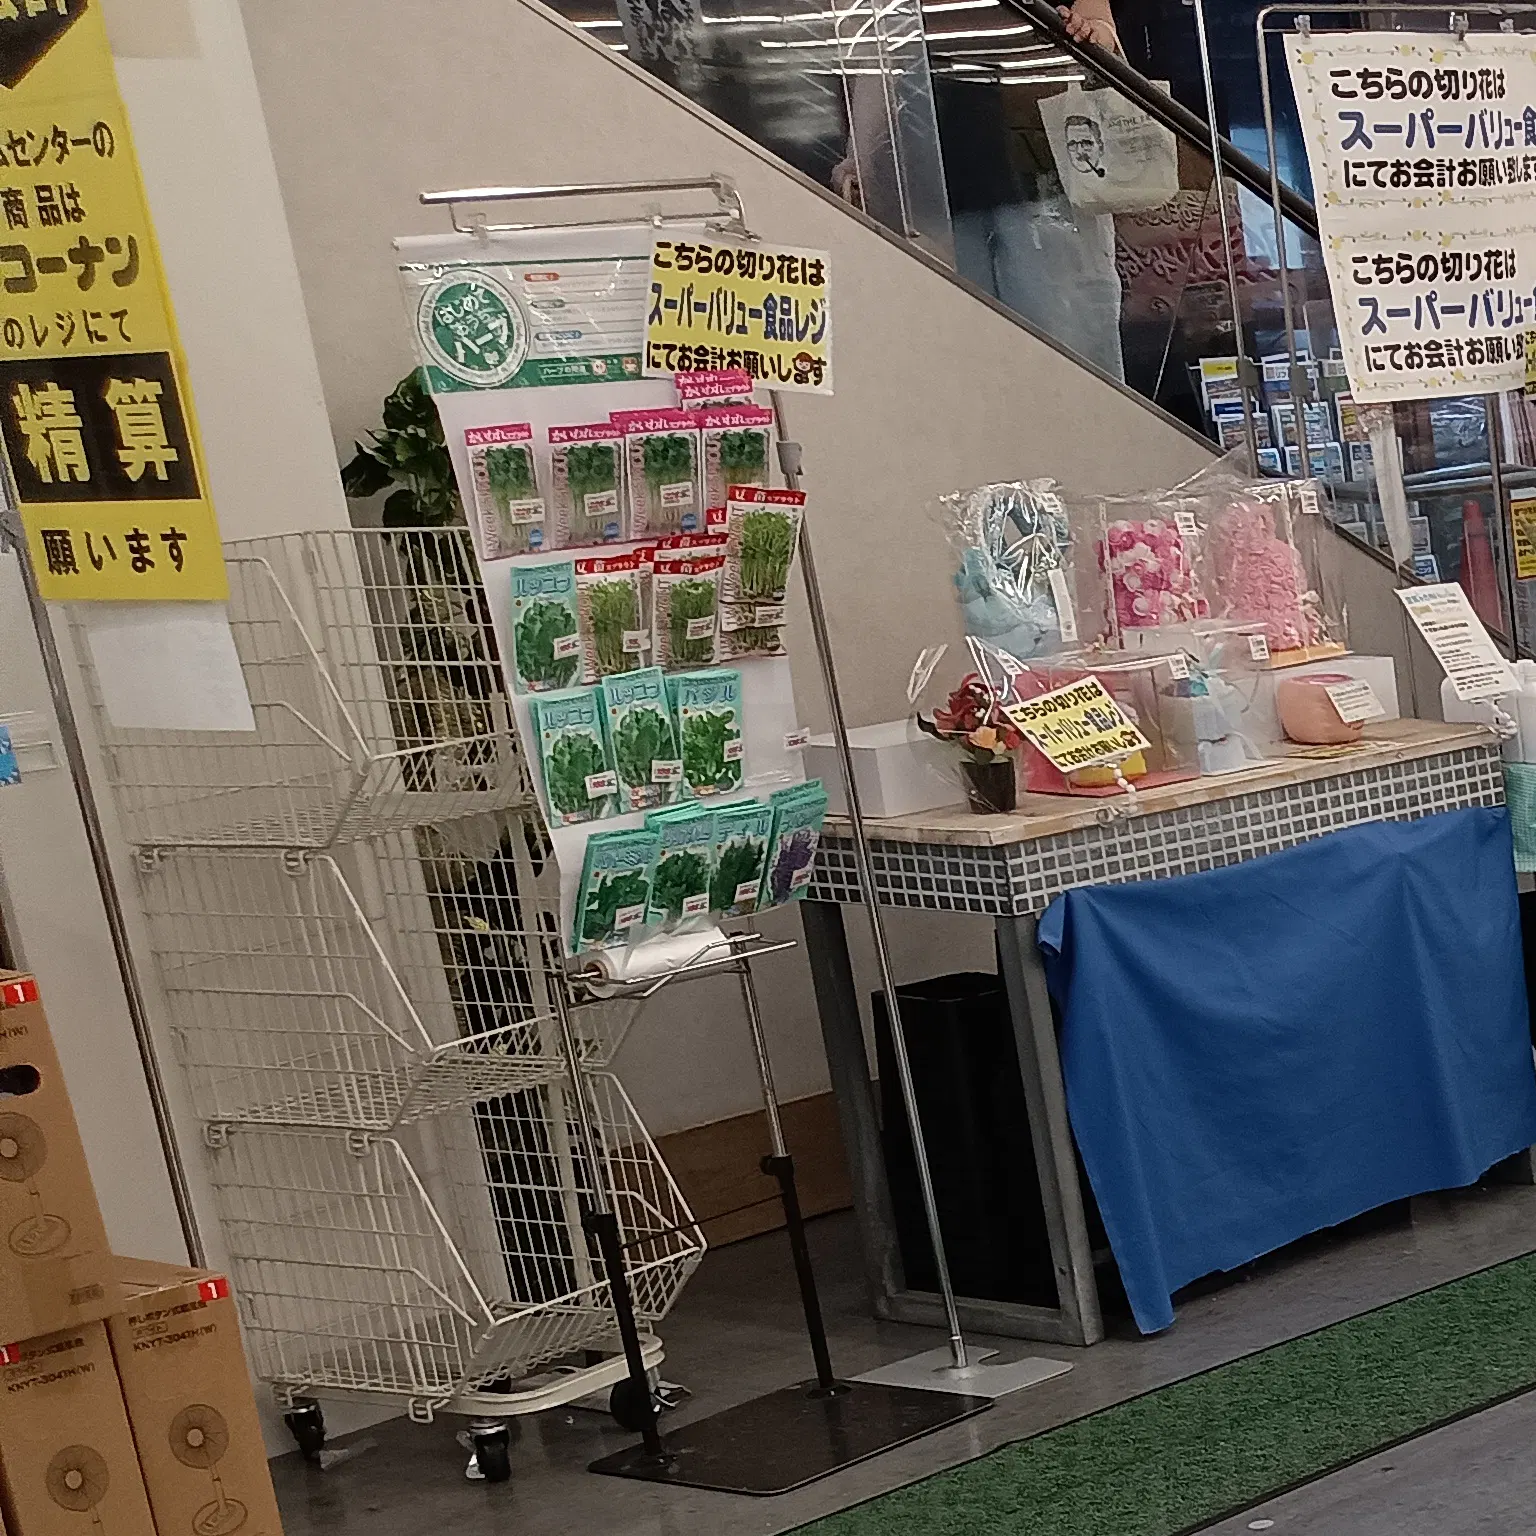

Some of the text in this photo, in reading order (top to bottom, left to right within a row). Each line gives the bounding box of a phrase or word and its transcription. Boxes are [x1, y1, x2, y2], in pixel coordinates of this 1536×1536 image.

[1329, 67, 1507, 100] こちらの切り花は
[0, 182, 87, 230] 商品は
[0, 234, 140, 294] コーナン
[653, 241, 826, 287] こちらの切り花は
[1350, 250, 1518, 286] こちらの切り花は
[3, 308, 132, 350] のレジにて
[647, 282, 828, 345] スーパーバリュー食品レジ
[12, 377, 180, 484] 精算
[40, 526, 188, 576] 願います
[1009, 681, 1104, 724] こちらの切り花は
[13, 983, 26, 1003] 1
[207, 1282, 218, 1299] 1
